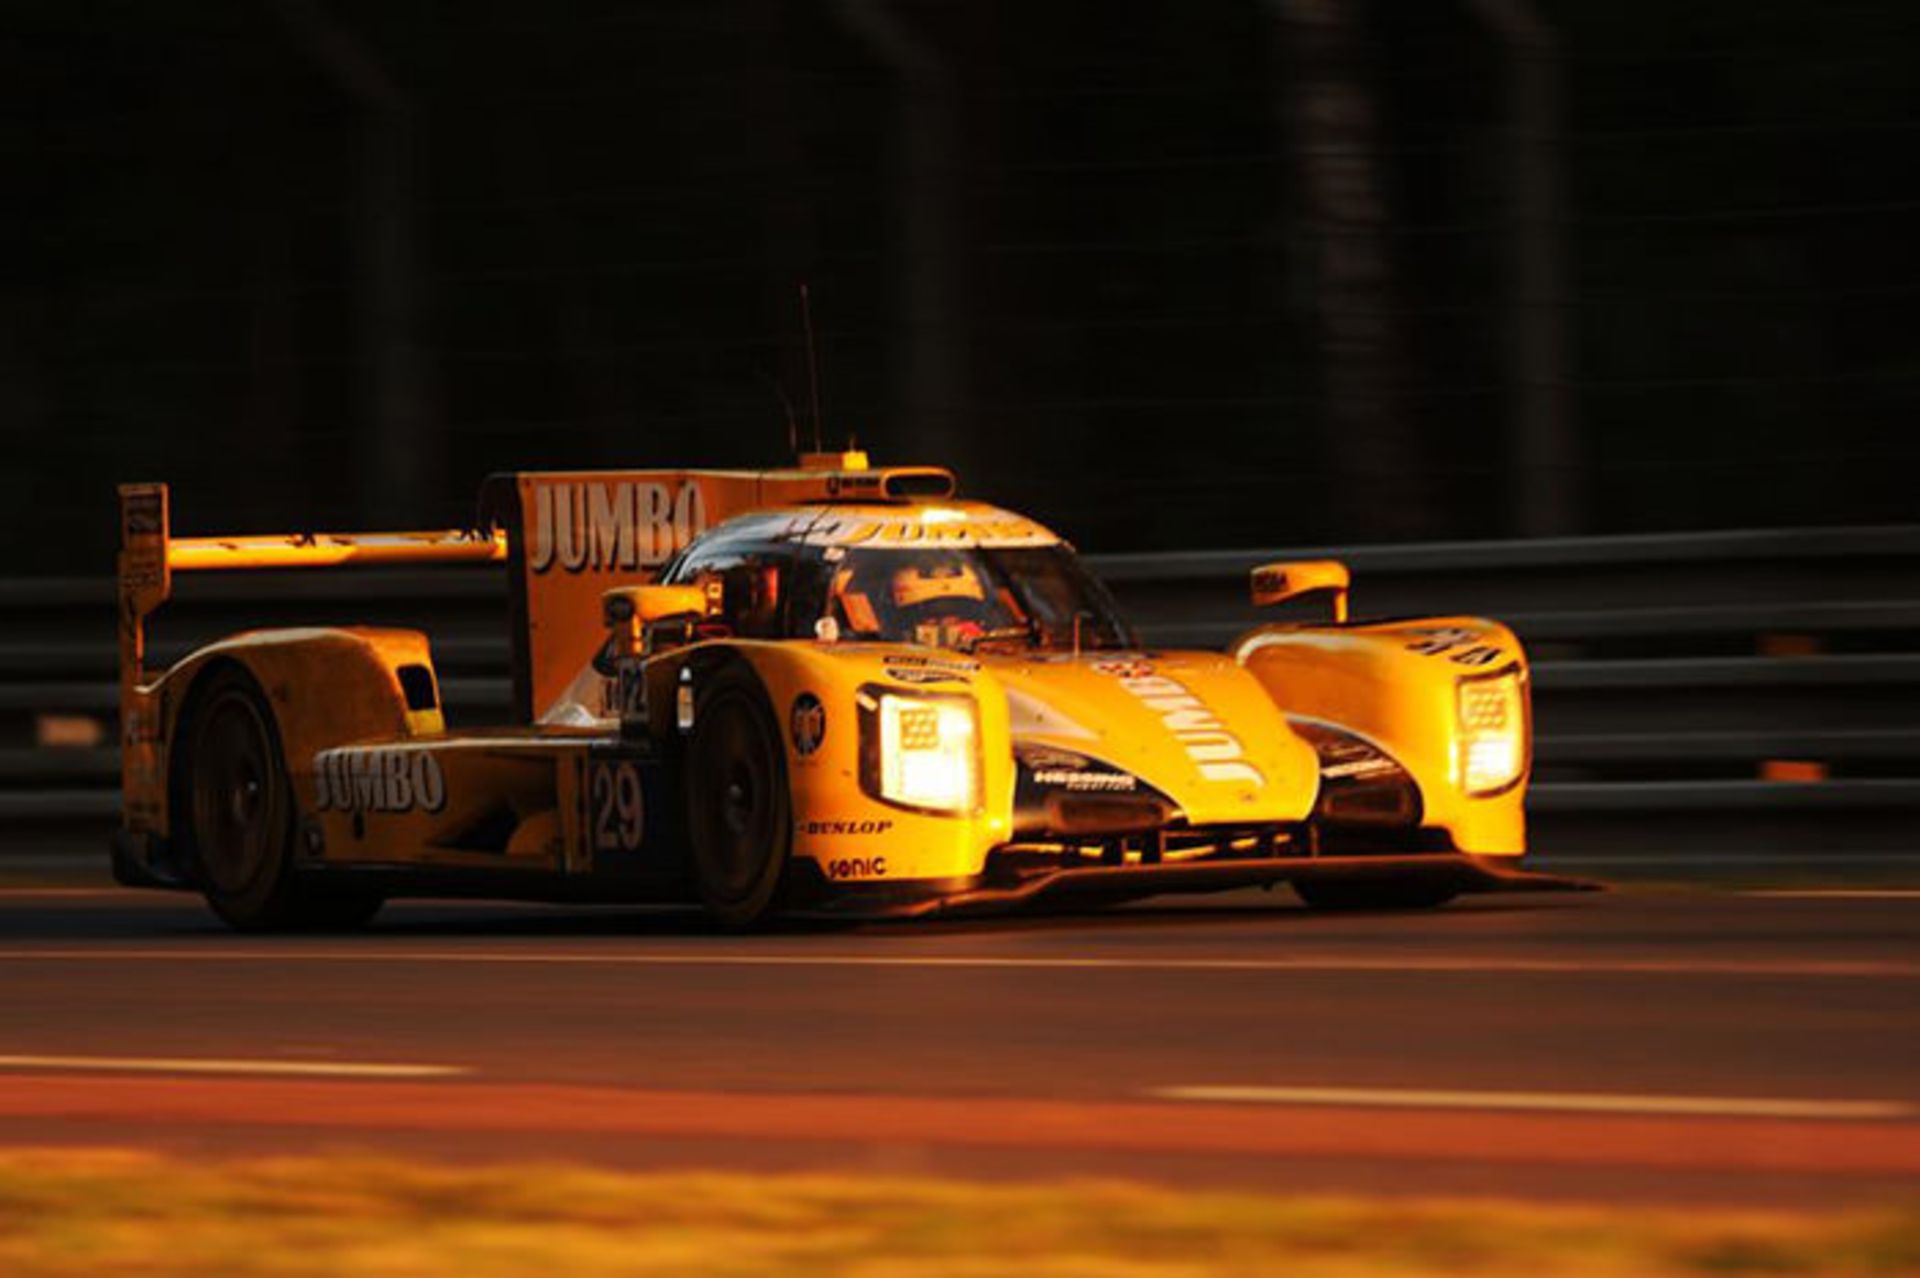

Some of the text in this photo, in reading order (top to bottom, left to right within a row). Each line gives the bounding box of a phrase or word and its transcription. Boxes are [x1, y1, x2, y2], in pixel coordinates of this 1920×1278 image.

[531, 480, 705, 573] JUMBO
[315, 751, 445, 812] JUMBO
[594, 761, 643, 851] 29
[807, 821, 893, 835] DUNLOP
